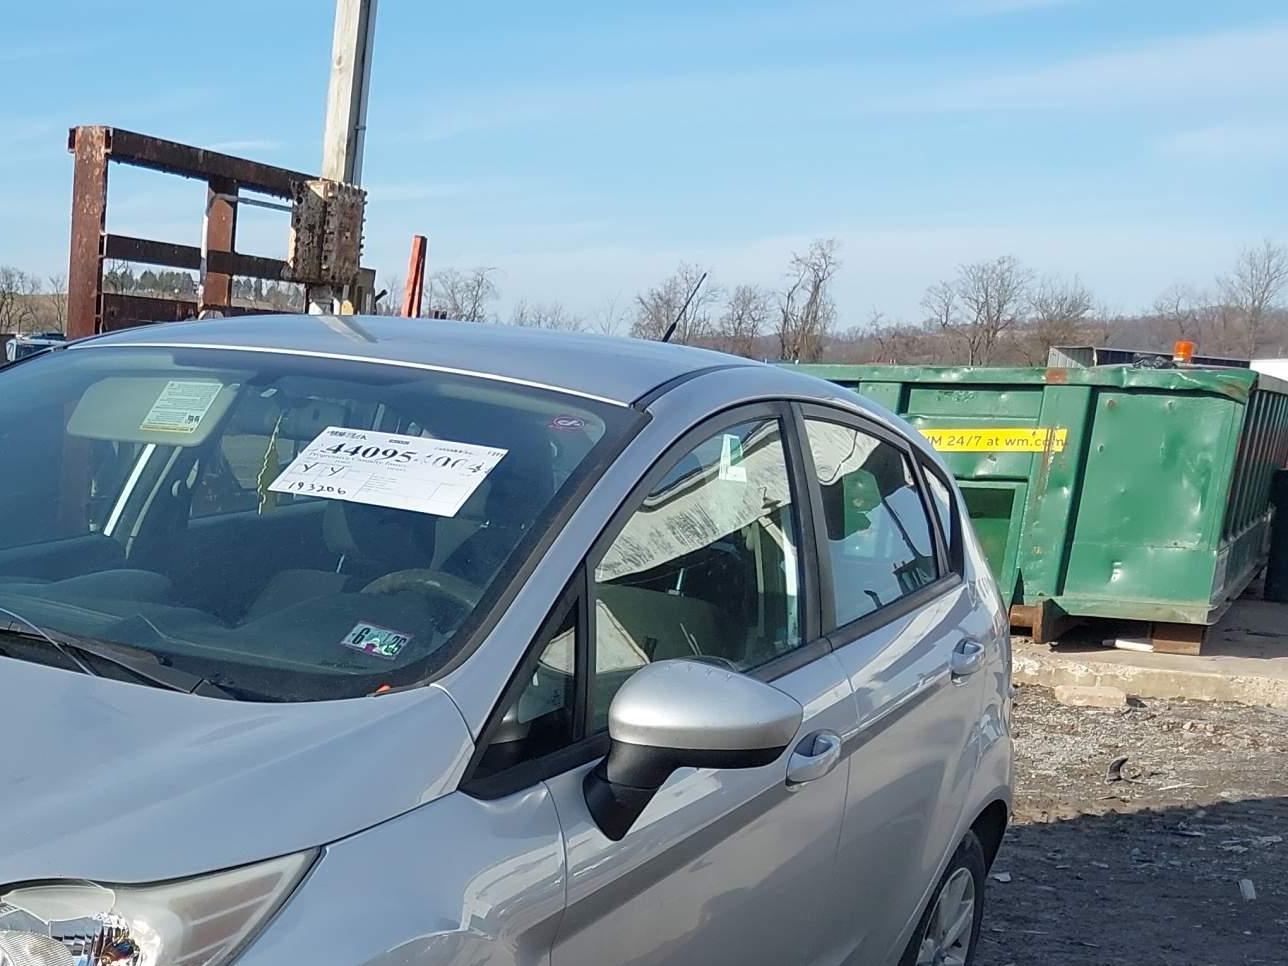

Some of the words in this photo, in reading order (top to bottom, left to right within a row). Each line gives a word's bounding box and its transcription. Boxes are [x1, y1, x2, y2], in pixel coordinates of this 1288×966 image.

[947, 435, 982, 446] 24/7
[986, 437, 999, 446] at
[352, 627, 371, 645] 6
[384, 635, 408, 655] 26
